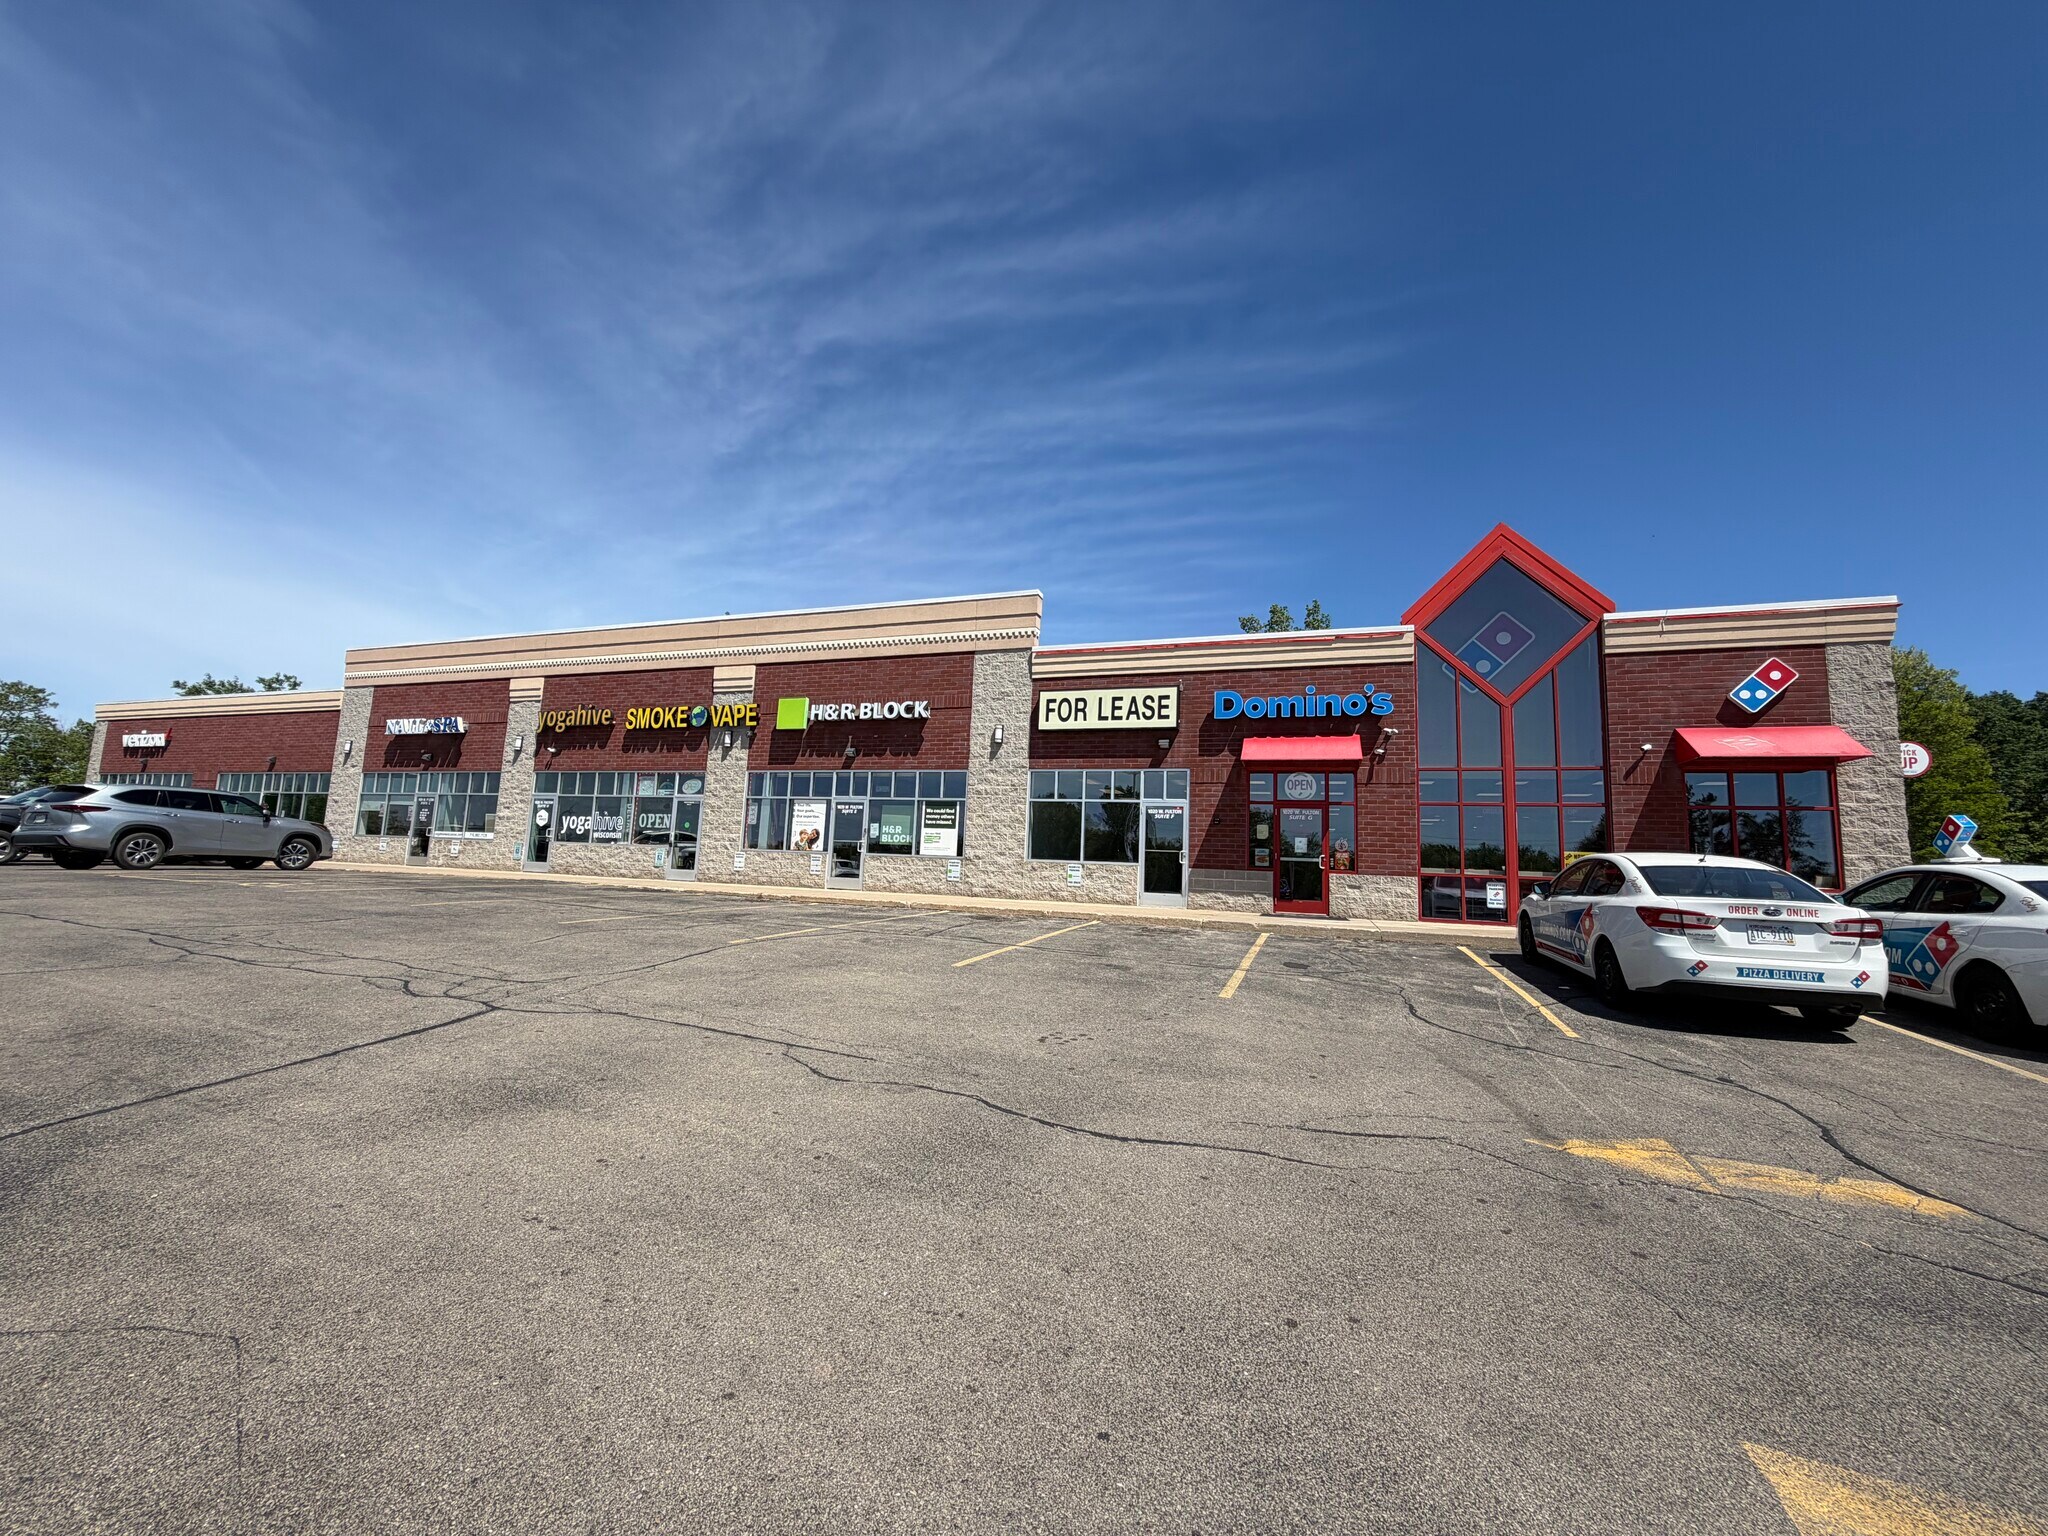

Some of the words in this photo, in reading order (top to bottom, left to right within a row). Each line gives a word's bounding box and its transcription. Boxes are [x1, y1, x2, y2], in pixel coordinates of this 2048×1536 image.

[1045, 697, 1088, 722] FOR
[1098, 695, 1170, 721] LEASE
[1214, 683, 1394, 719] Domino's
[536, 704, 612, 733] yogahive
[626, 706, 689, 729] SMOKE
[710, 704, 757, 727] VAPE
[810, 703, 856, 721] H&R
[859, 701, 931, 720] BLOCK
[433, 716, 463, 734] SPA
[1286, 779, 1313, 791] OPEN
[639, 813, 672, 829] OPEN
[882, 825, 902, 834] H&R
[881, 834, 913, 843] BLOCK
[1728, 905, 1758, 916] ORDER
[1786, 908, 1820, 918] ONLINE
[1742, 968, 1771, 979] PIZZA
[1773, 970, 1820, 982] DELIVERY
